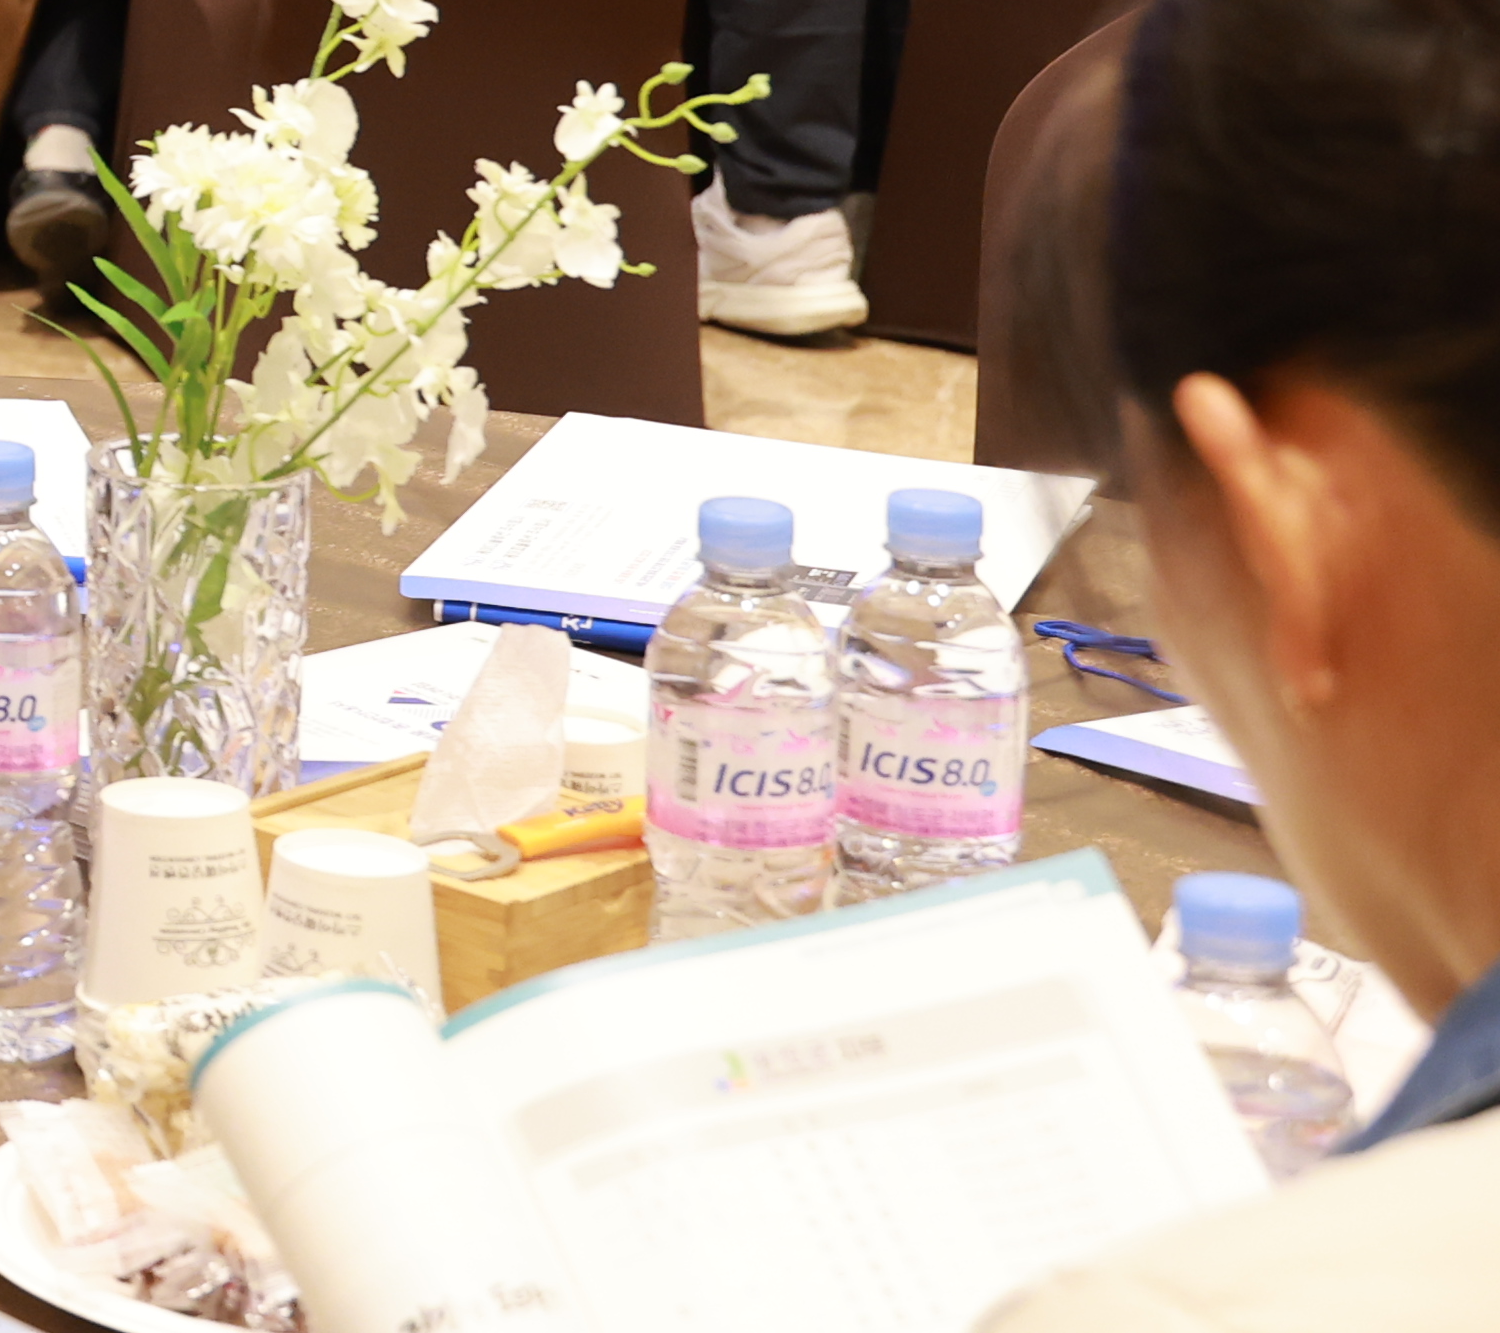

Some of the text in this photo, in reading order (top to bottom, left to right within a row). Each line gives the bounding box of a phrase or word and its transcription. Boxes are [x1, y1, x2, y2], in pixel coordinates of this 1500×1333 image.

[714, 763, 792, 798] ICIS
[860, 743, 990, 788] ICIS 8.0
